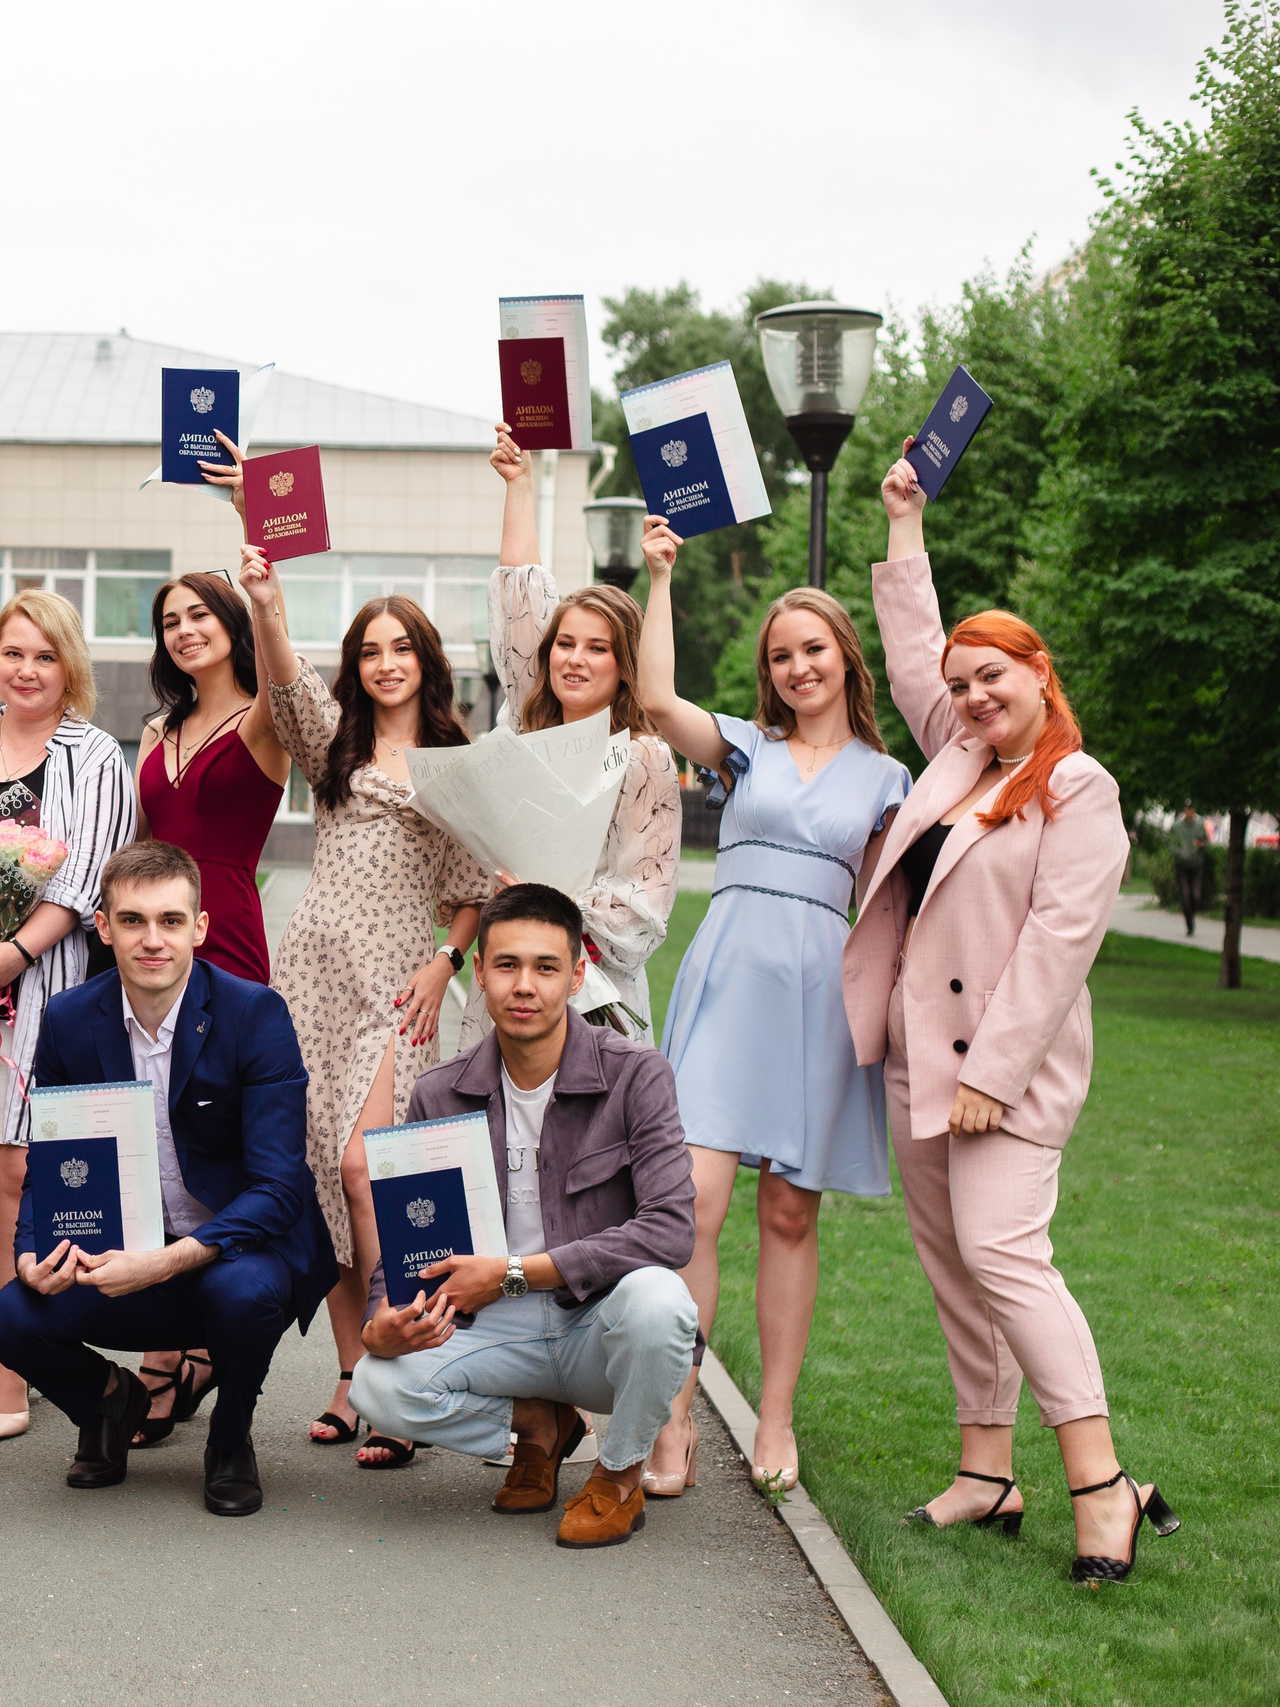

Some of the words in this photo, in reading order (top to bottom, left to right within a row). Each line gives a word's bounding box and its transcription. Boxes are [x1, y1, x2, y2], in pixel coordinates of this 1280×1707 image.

[516, 405, 554, 416] ДИПЛОМ
[179, 433, 220, 443] ДИПЛО
[926, 430, 951, 458] ДИПЛОМ
[663, 480, 709, 503] ДИПЛОМ
[263, 512, 308, 529] ДИПЛОМ
[52, 1210, 103, 1222] ДИПЛОМ
[403, 1247, 454, 1265] ДИПЛОМ
